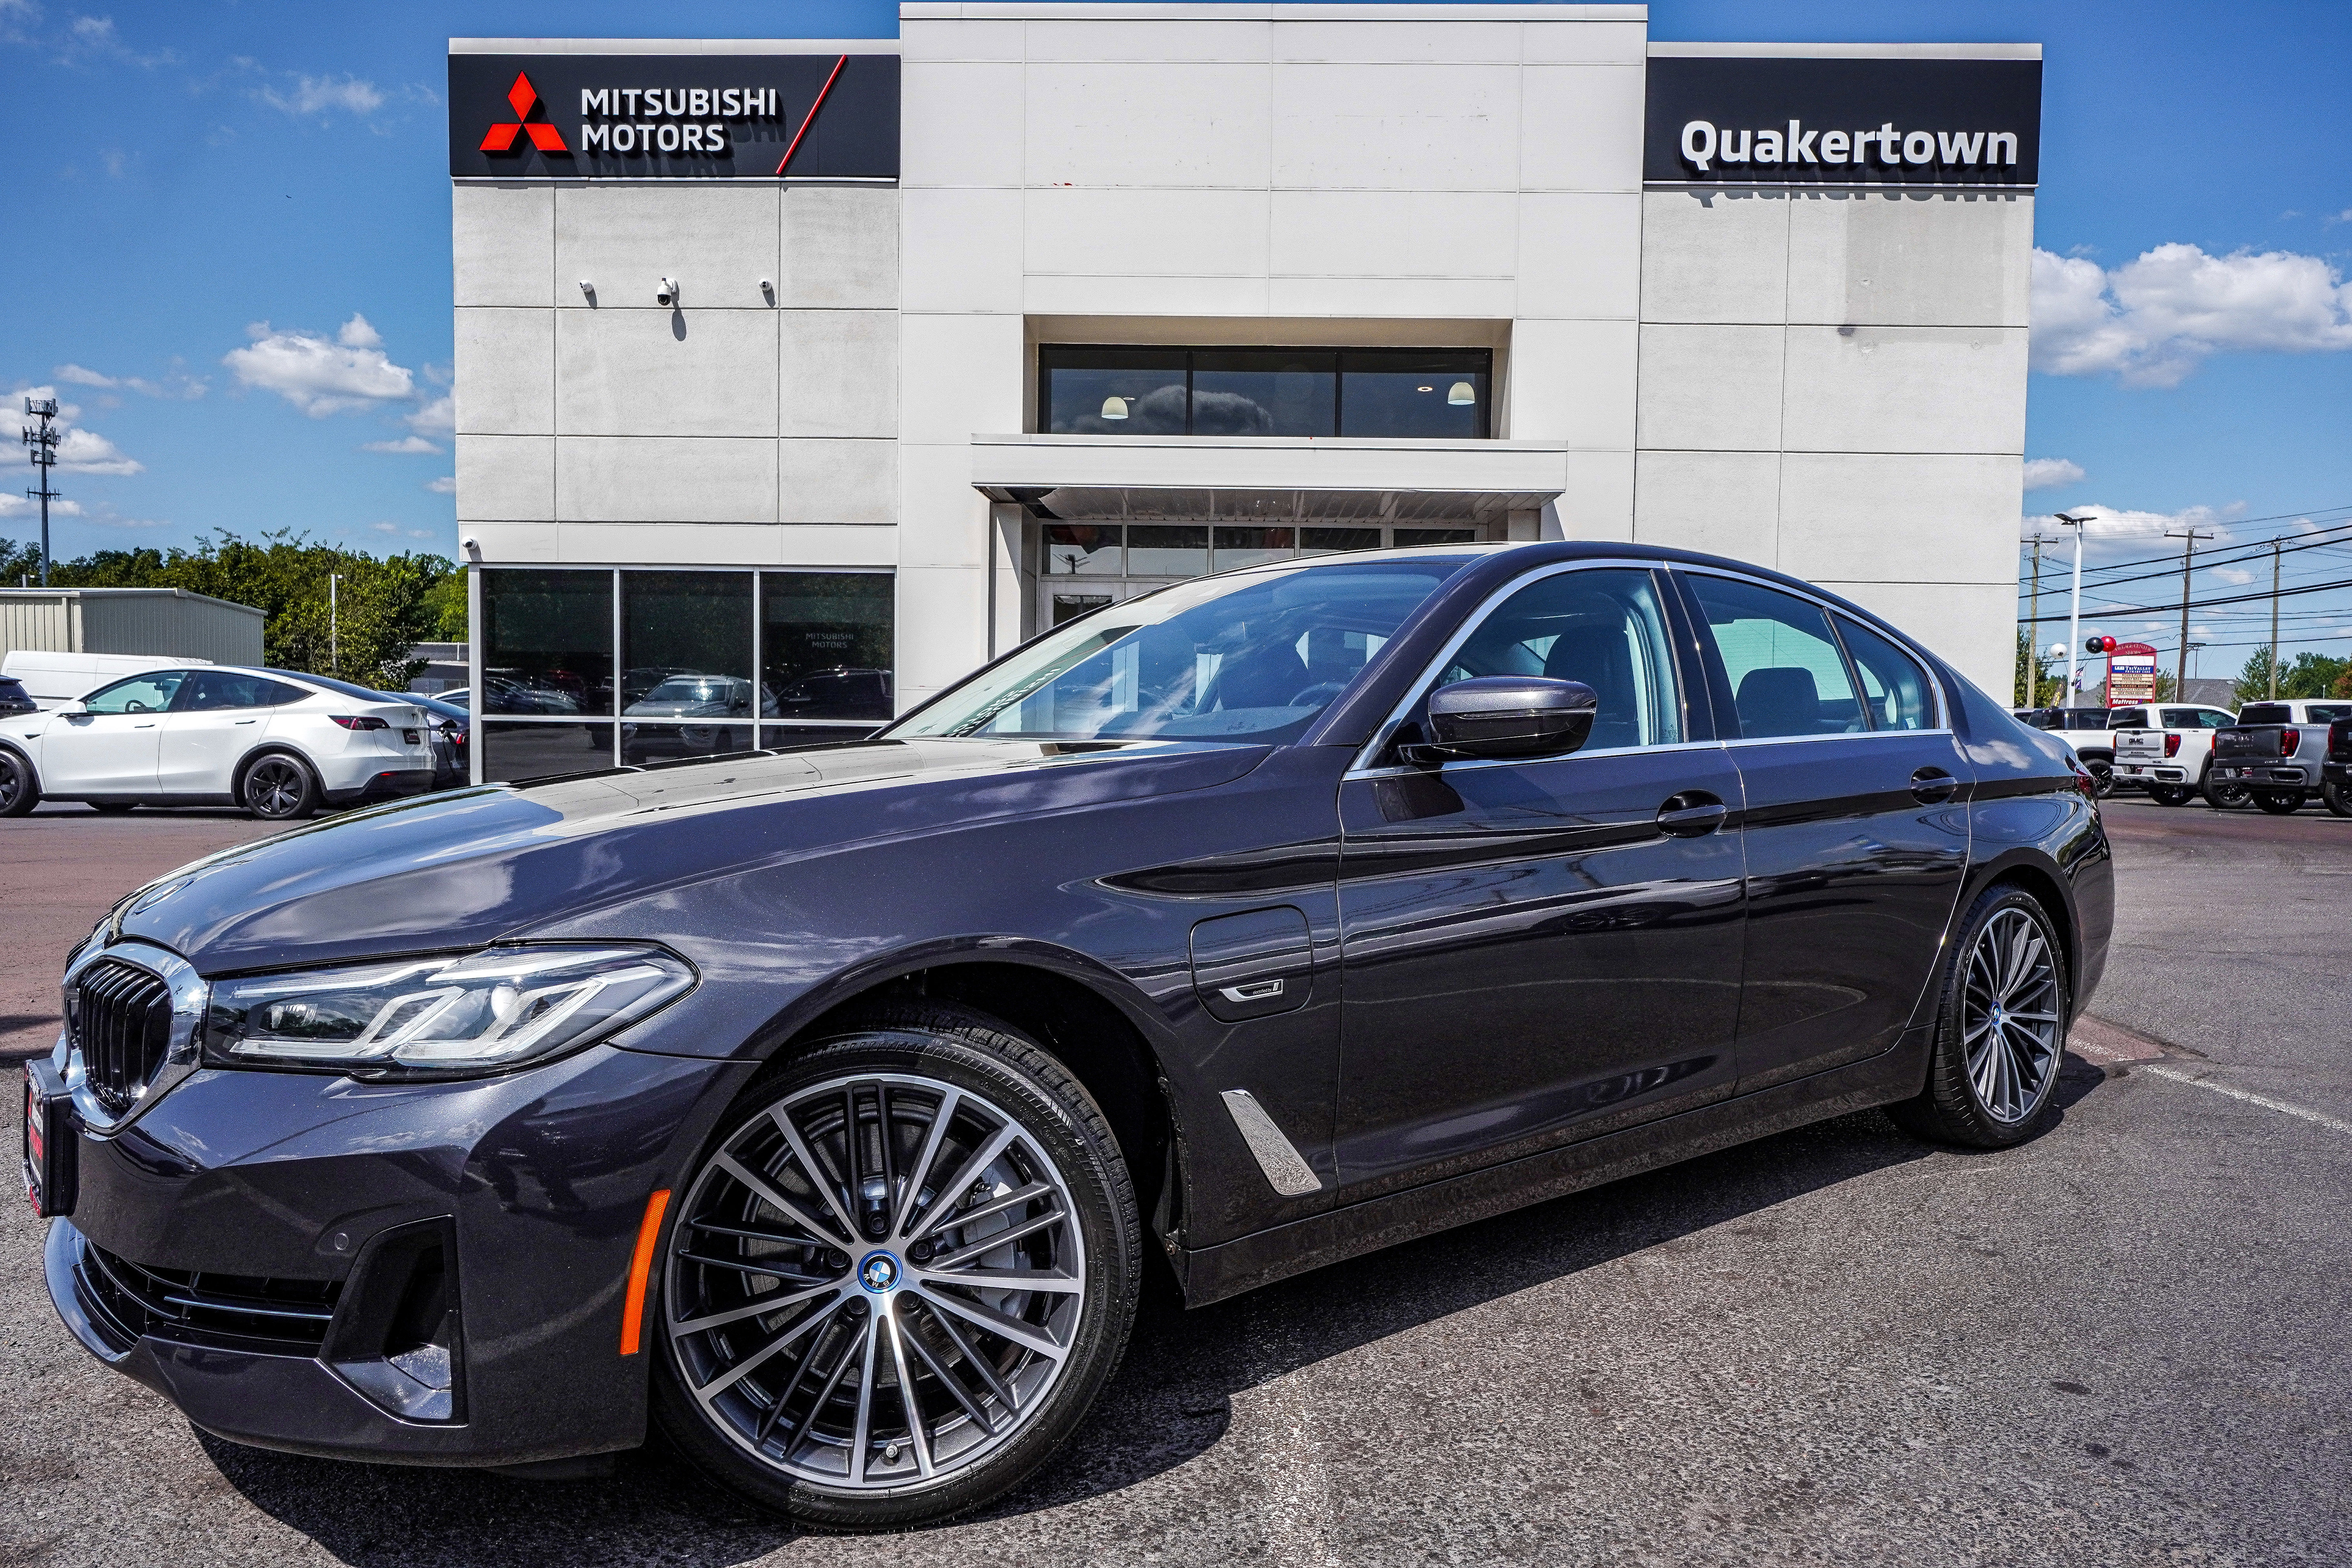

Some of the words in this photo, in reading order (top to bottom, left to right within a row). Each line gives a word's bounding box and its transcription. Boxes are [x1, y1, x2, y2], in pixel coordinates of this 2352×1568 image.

[581, 88, 776, 116] MITSUBISHI
[582, 124, 724, 151] MOTORS
[1681, 120, 2017, 170] Quakertown
[864, 1273, 890, 1287] BMW
